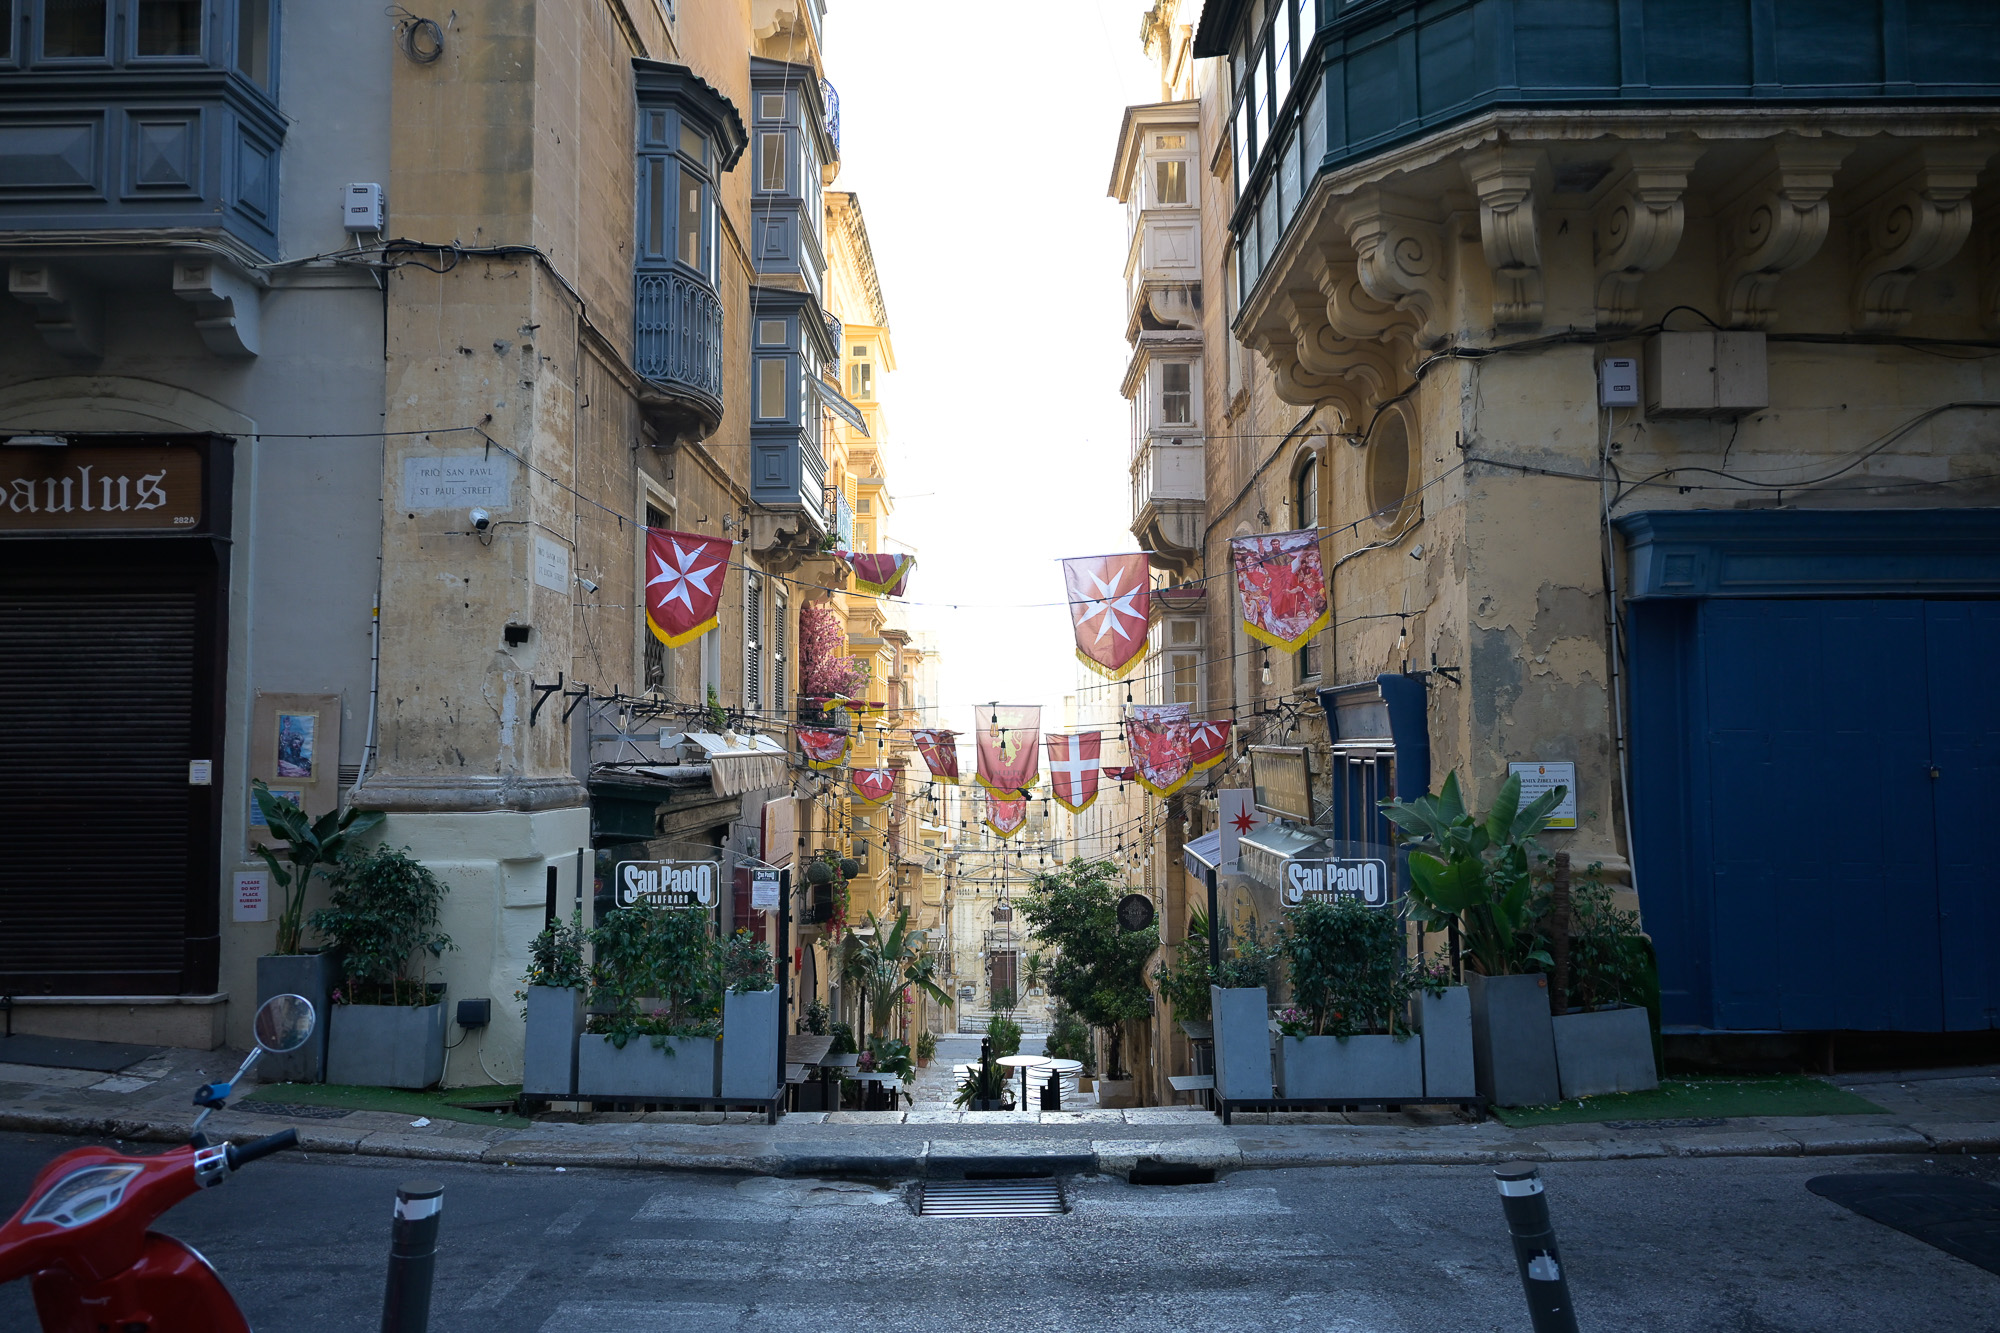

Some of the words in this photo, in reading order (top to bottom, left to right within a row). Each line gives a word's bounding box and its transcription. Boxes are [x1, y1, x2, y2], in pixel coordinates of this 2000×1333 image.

[421, 468, 440, 477] TRIQ
[446, 468, 465, 477] SAN
[469, 468, 493, 476] PAWL
[420, 487, 430, 495] ST
[435, 487, 456, 495] PAUL
[462, 486, 492, 495] STREET
[173, 516, 195, 524] 282A
[624, 865, 658, 903] San
[1288, 863, 1323, 902] San
